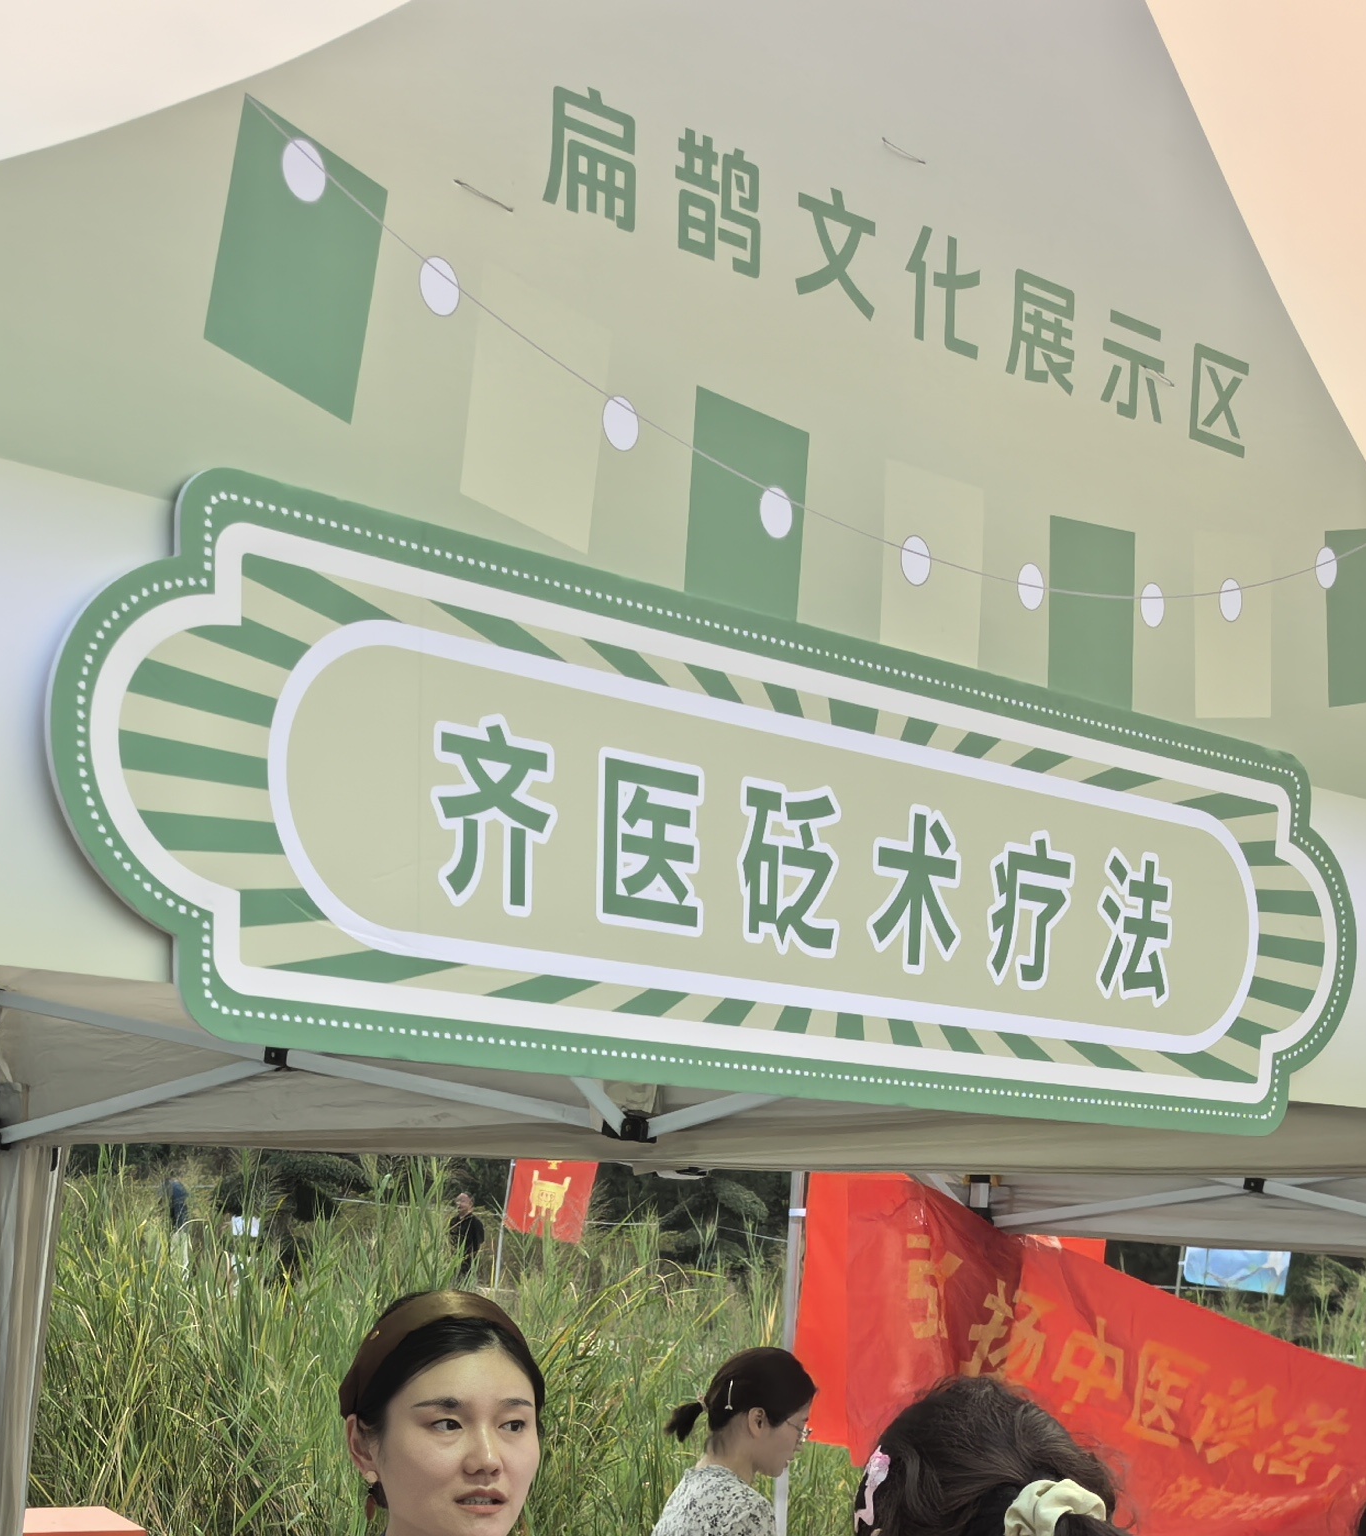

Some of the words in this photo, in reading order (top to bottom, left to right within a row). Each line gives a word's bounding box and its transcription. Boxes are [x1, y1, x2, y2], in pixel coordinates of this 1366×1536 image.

[542, 86, 1250, 459] 扁鹊文化展示区
[434, 720, 1173, 1005] 齐医砭术疗法
